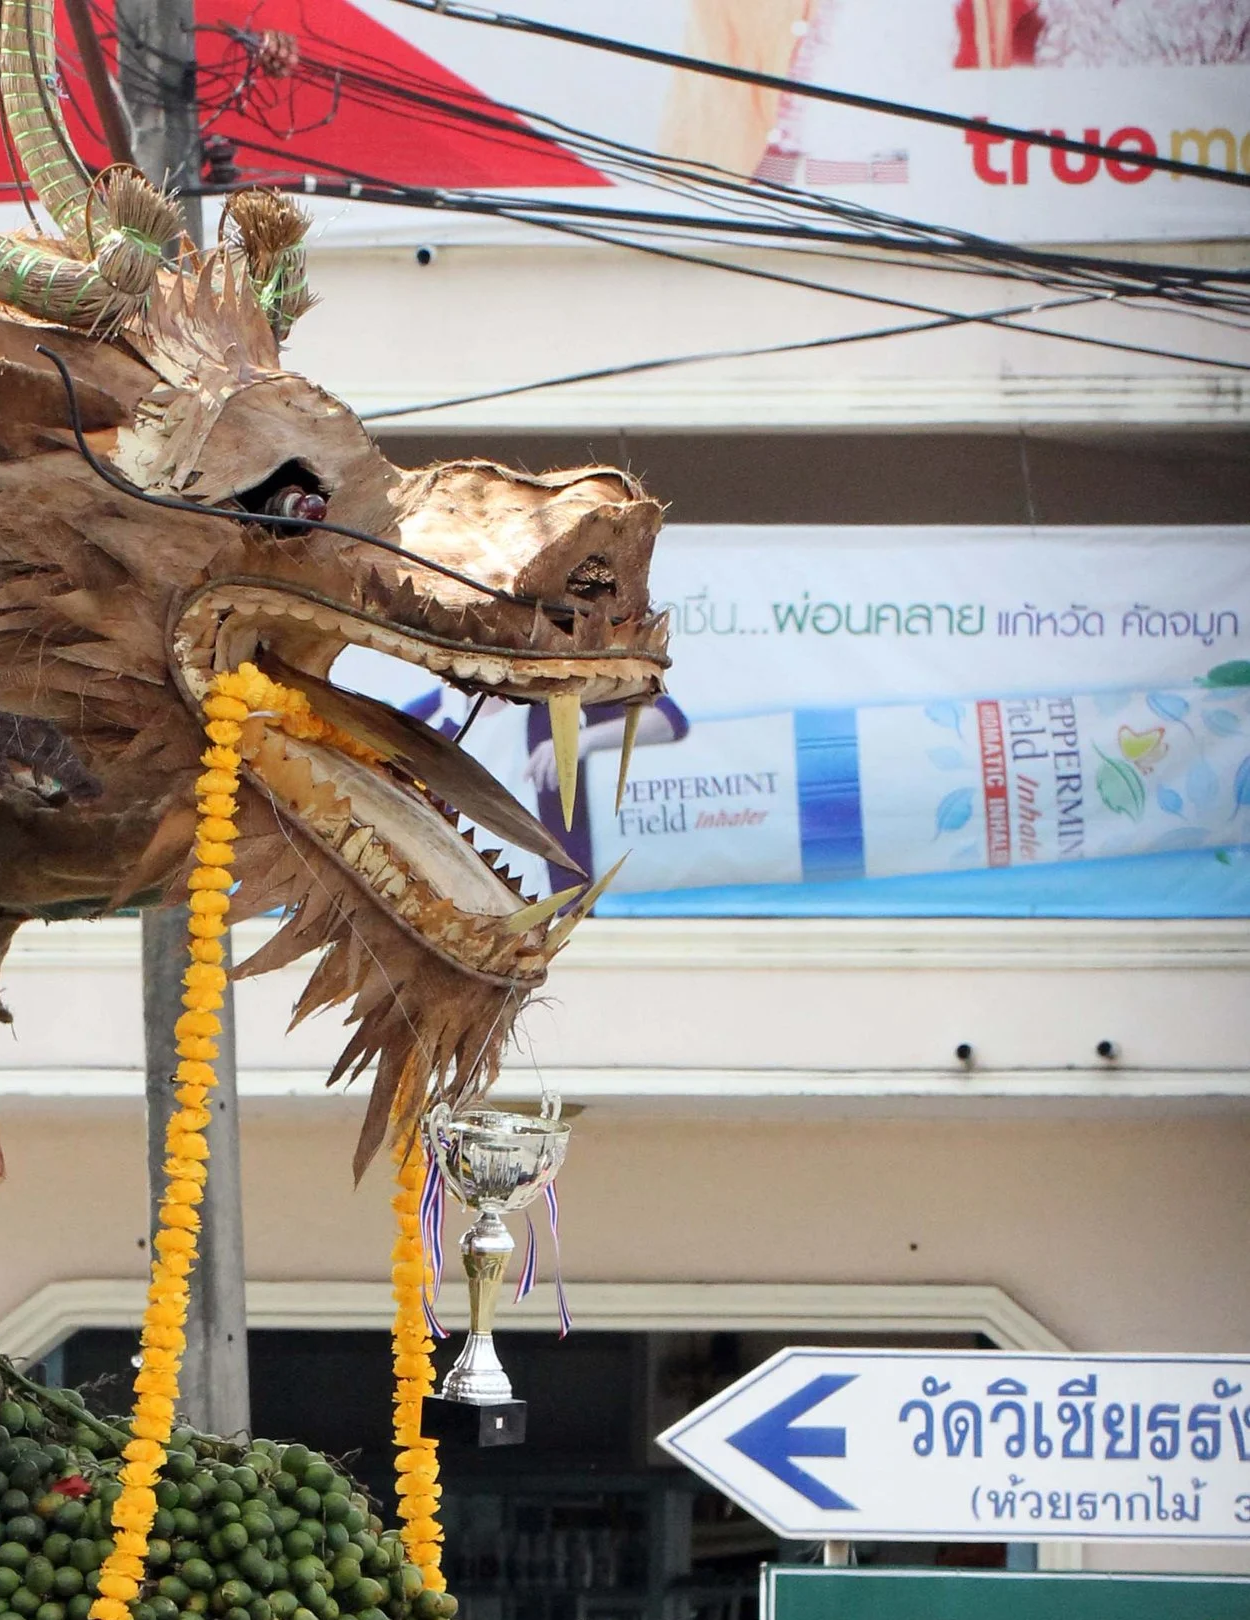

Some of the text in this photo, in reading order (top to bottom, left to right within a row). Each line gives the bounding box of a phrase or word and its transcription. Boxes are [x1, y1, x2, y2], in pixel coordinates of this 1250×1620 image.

[1170, 126, 1250, 182] m
[997, 602, 1105, 638] แก้หวัด
[1121, 602, 1239, 647] คัดจมูก
[618, 803, 688, 837] Field
